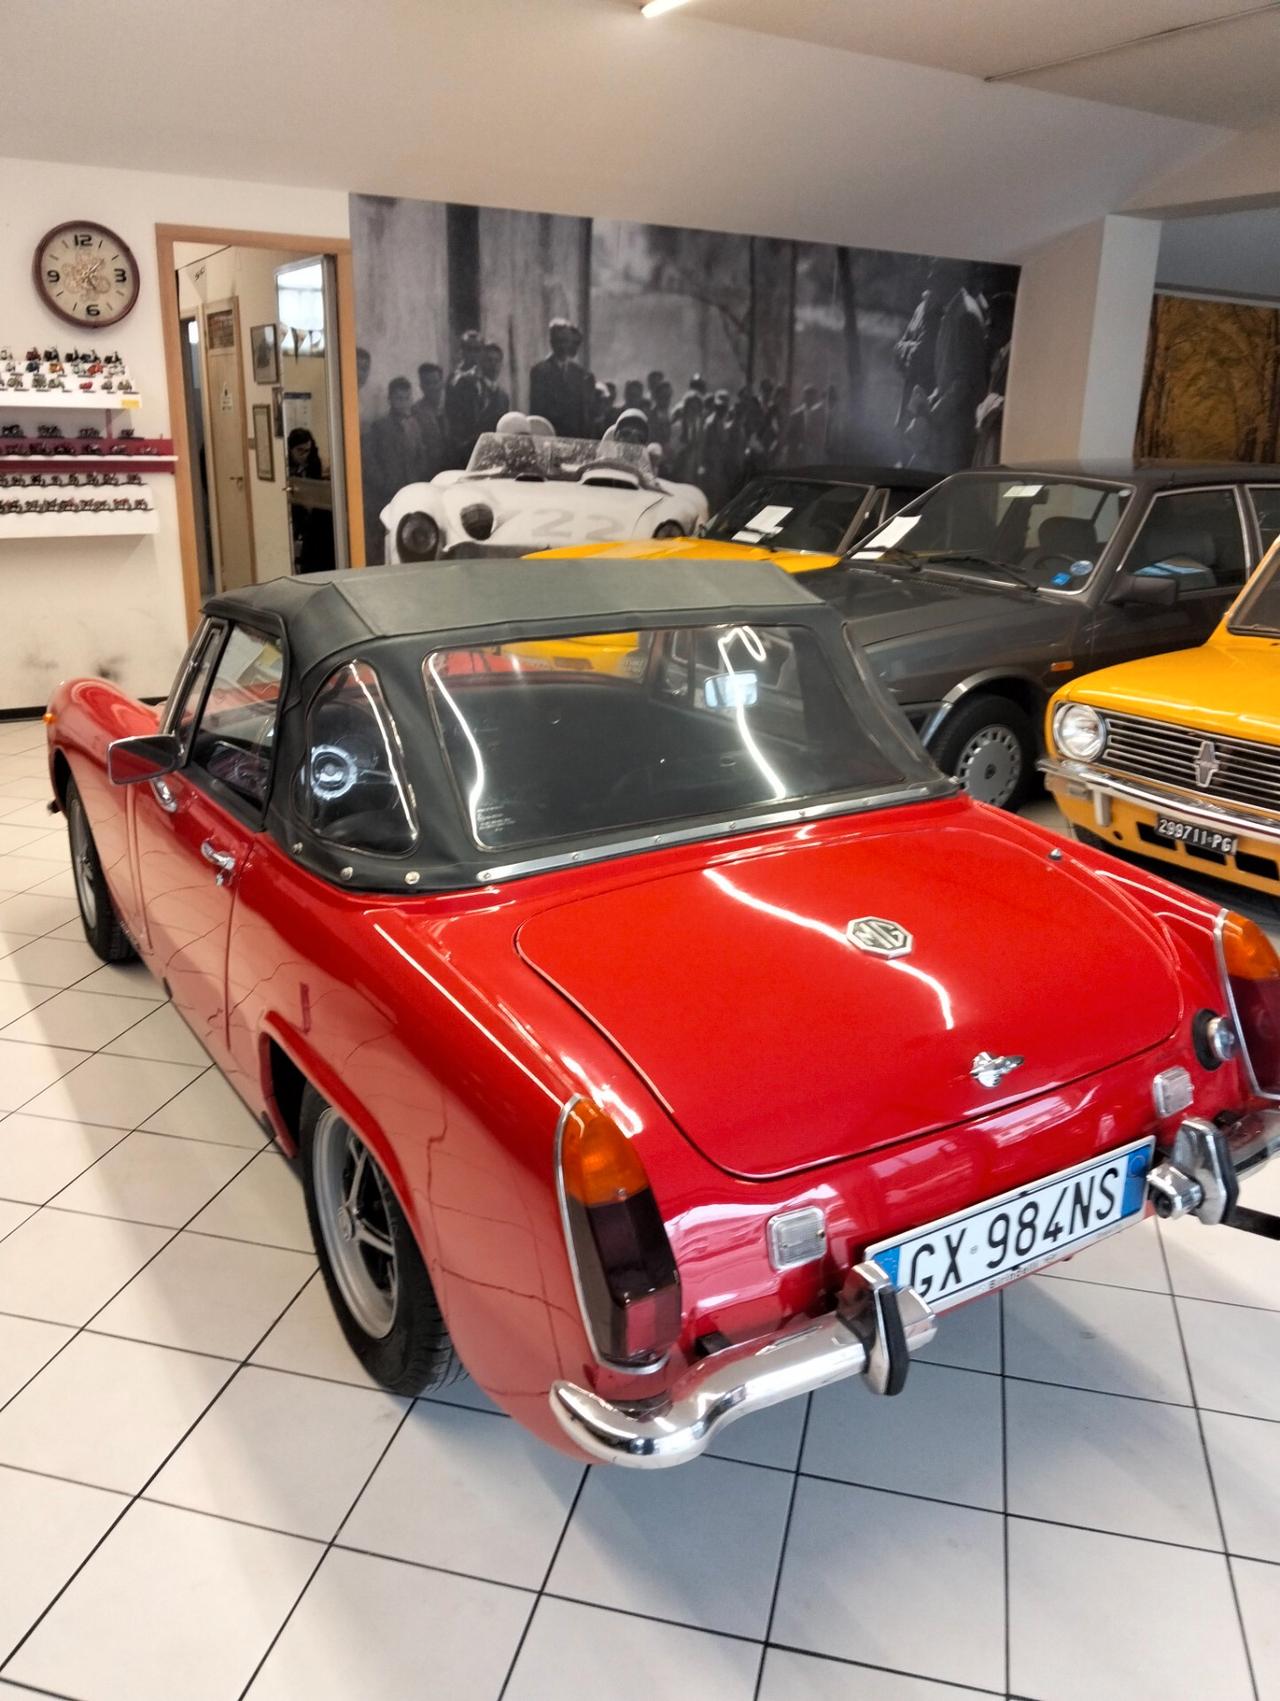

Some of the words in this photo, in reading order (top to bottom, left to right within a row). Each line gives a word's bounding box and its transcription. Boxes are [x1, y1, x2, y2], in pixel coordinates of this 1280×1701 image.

[74, 234, 93, 247] 12
[47, 269, 60, 283] 9
[114, 268, 127, 283] 3
[86, 304, 100, 316] 6
[851, 919, 908, 950] MG
[910, 1228, 967, 1297] GX
[986, 1167, 1119, 1269] 984NS
